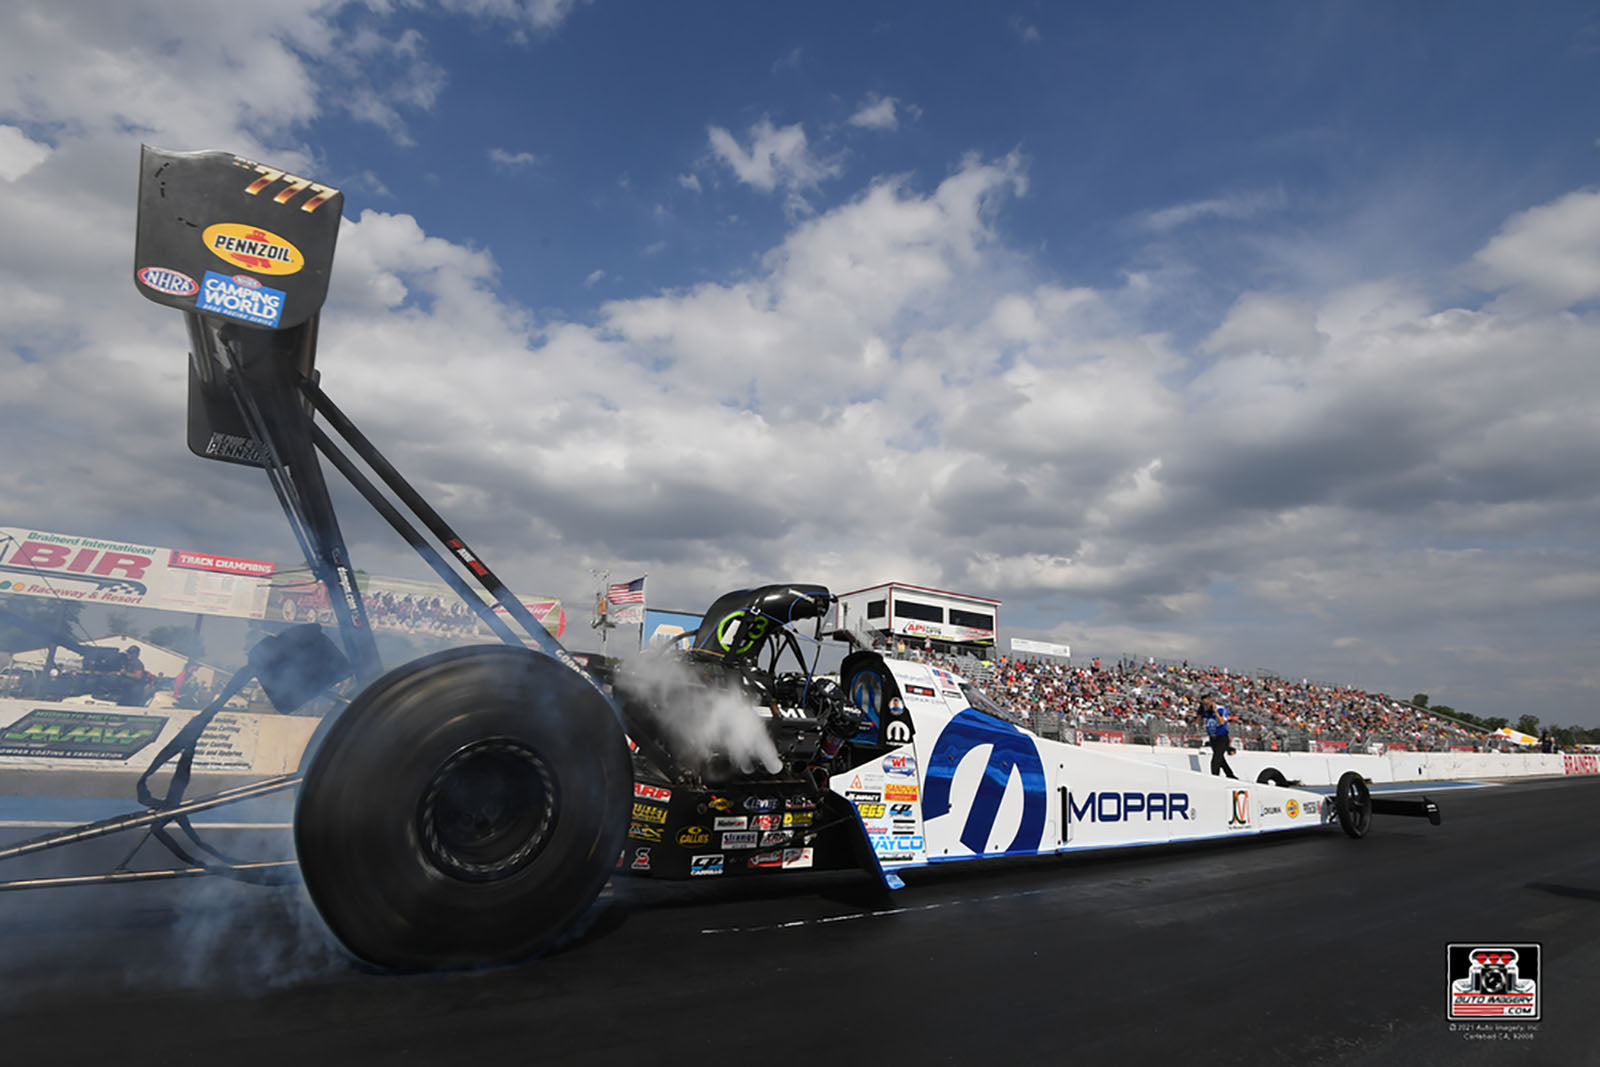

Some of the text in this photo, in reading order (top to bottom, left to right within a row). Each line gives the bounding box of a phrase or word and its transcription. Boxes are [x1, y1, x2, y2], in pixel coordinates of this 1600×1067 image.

[245, 165, 340, 213] 777
[214, 234, 291, 263] PENNZOIL
[148, 271, 191, 292] NHRA
[205, 279, 281, 308] CAMPING
[204, 288, 278, 319] WORLD
[27, 531, 157, 555] Brainerd International
[8, 540, 153, 580] BIR
[181, 555, 272, 573] TRACK CHAMPIONS
[27, 583, 87, 599] Raceway
[101, 592, 144, 604] Resort
[1068, 791, 1190, 823] MOPAR
[753, 815, 781, 826] MSD
[869, 836, 923, 850] AYCO
